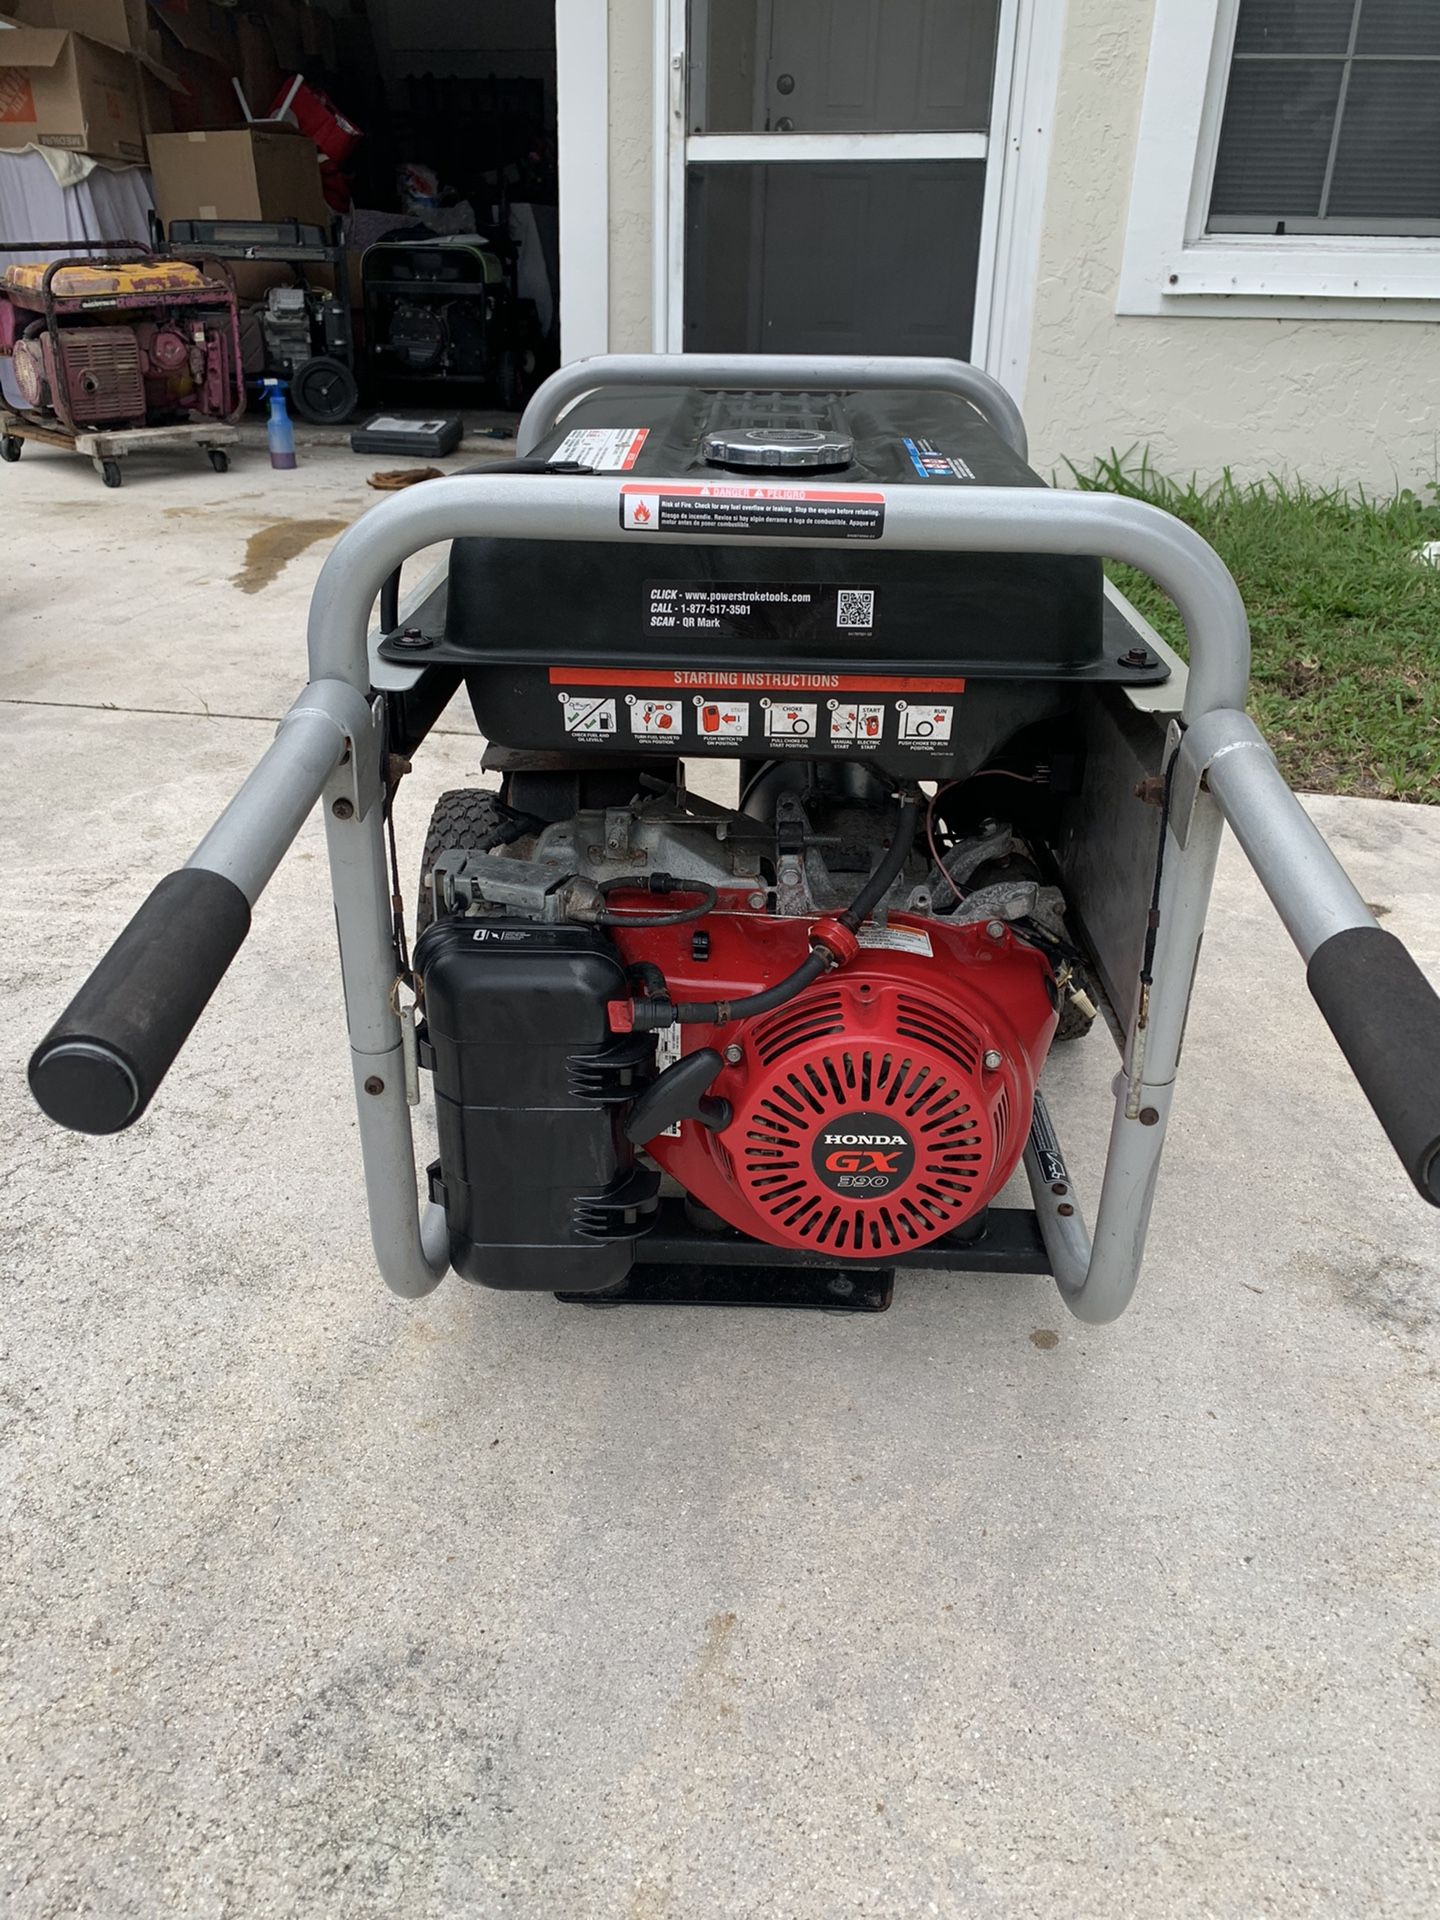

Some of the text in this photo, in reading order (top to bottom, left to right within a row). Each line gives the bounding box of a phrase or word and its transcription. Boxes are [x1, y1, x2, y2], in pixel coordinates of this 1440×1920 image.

[713, 487, 806, 499] DANGER PELIGRO
[661, 501, 674, 509] Risk
[695, 502, 711, 510] Check
[742, 504, 764, 512] overflow
[772, 505, 793, 513] leaking.
[795, 506, 807, 514] Stop
[808, 506, 816, 514] the
[818, 507, 835, 515] engine
[855, 508, 881, 516] refueling.
[661, 511, 680, 519] Riesgo
[688, 512, 712, 520] incendie.
[766, 516, 788, 524] derrame
[814, 518, 848, 526] combustible.
[650, 589, 678, 600] CLICK
[685, 591, 811, 602] www.powerstroketools.com
[650, 602, 673, 613] CALL
[681, 604, 751, 615] 1-877-617-3501
[650, 616, 675, 627] SCAN
[682, 617, 696, 628] QR
[697, 617, 721, 628] Mark
[673, 671, 840, 688] STARTING INSTRUCTIONS
[824, 1134, 908, 1145] HONDA
[825, 1150, 904, 1173] GX
[837, 1175, 889, 1188] 390
